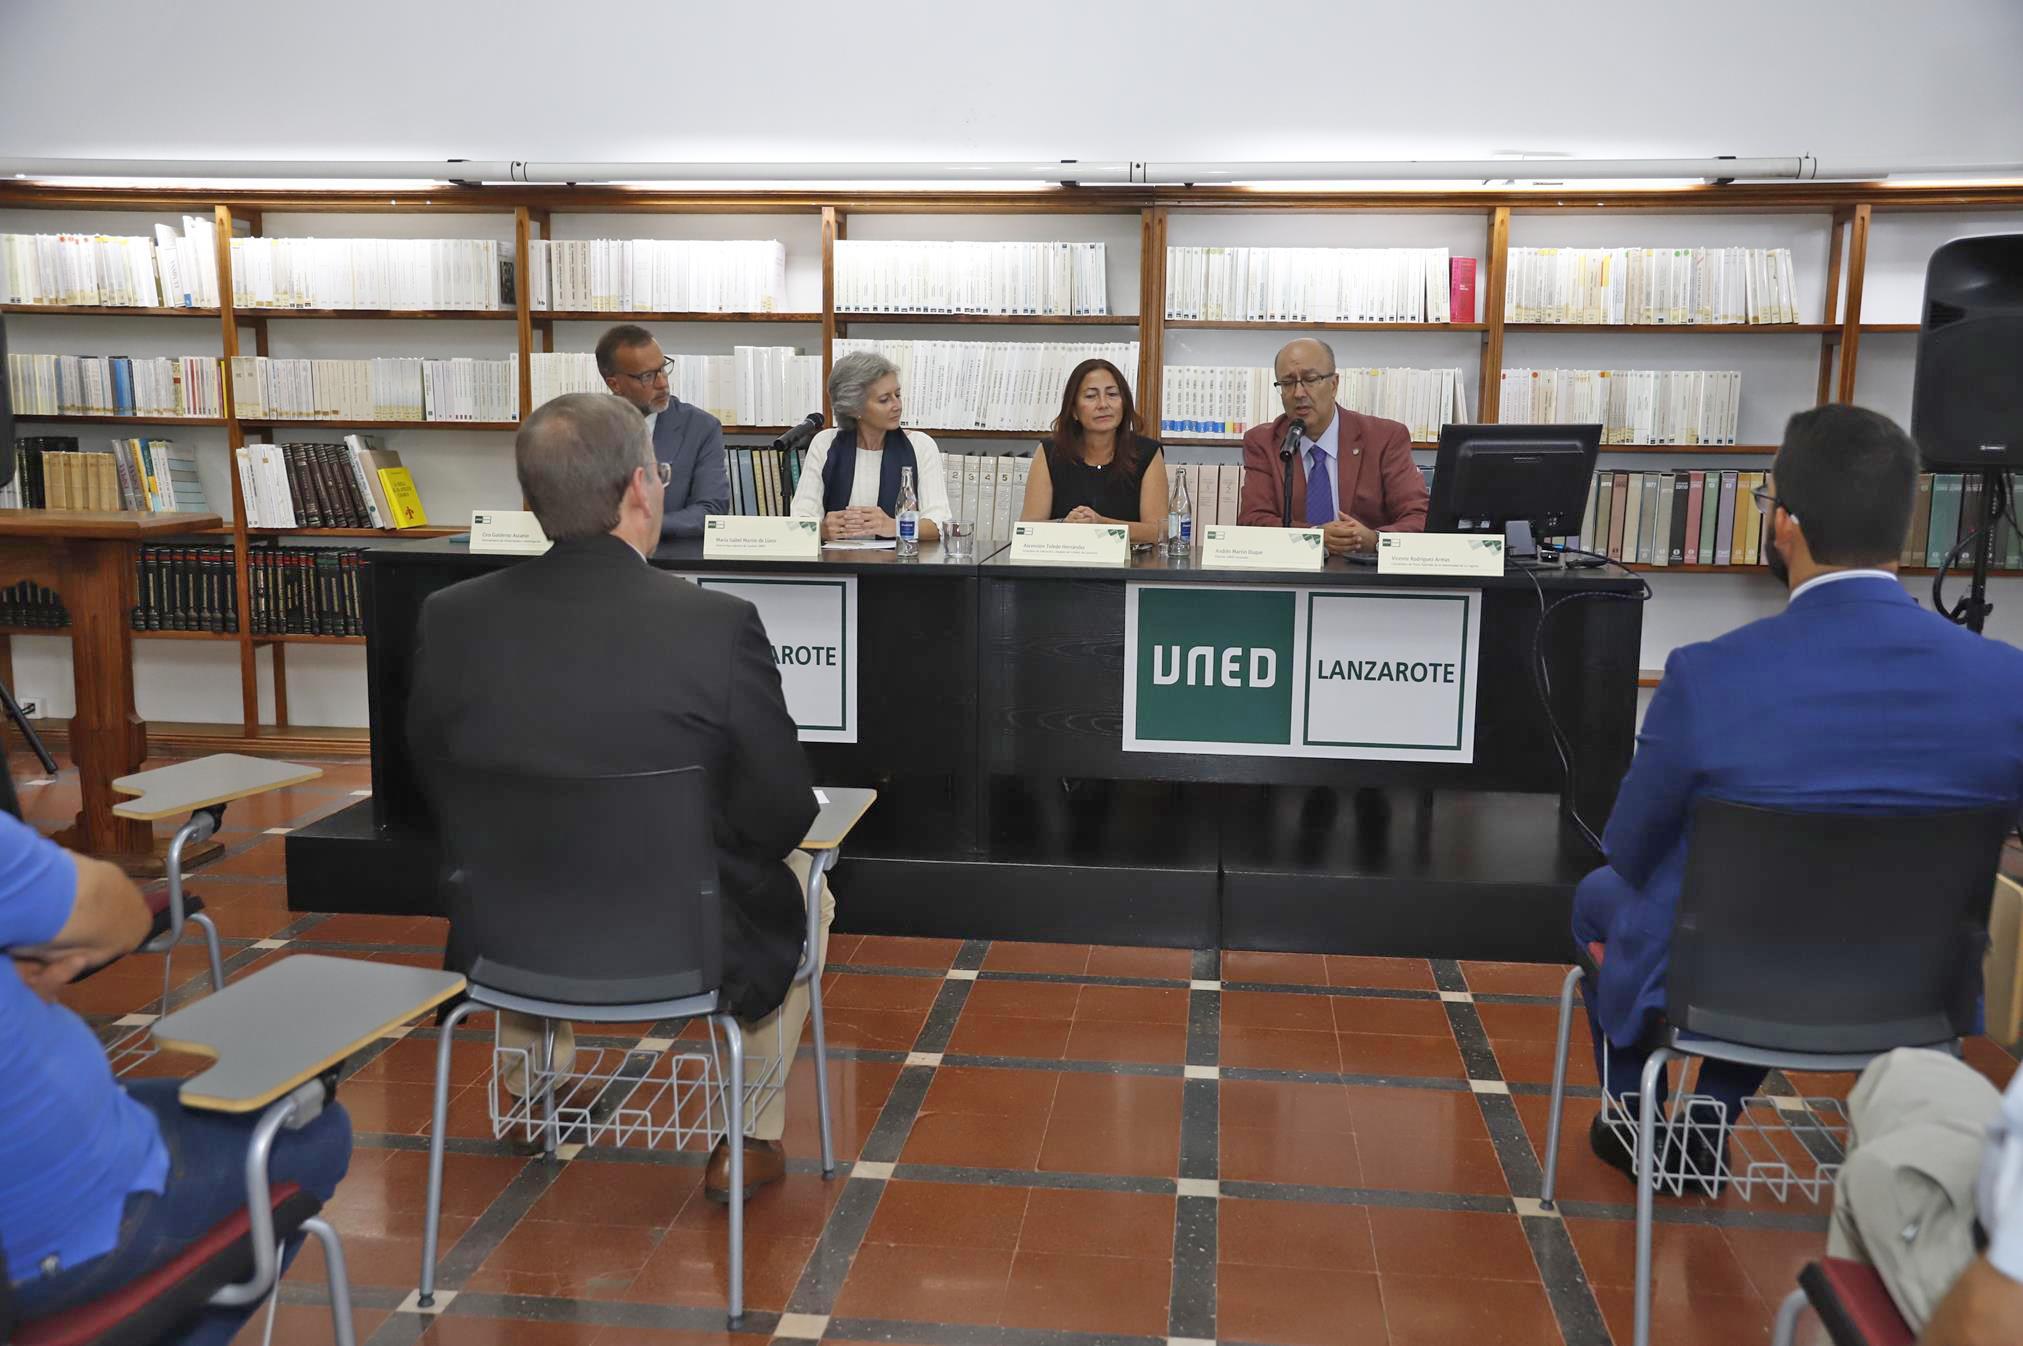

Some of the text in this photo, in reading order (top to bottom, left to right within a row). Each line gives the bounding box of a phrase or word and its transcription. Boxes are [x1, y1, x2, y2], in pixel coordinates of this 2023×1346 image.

[951, 471, 959, 480] 2
[968, 473, 975, 481] 3
[1002, 474, 1009, 482] 5
[769, 645, 837, 667] AROTE
[1152, 644, 1456, 688] UNED LANZAROTE
